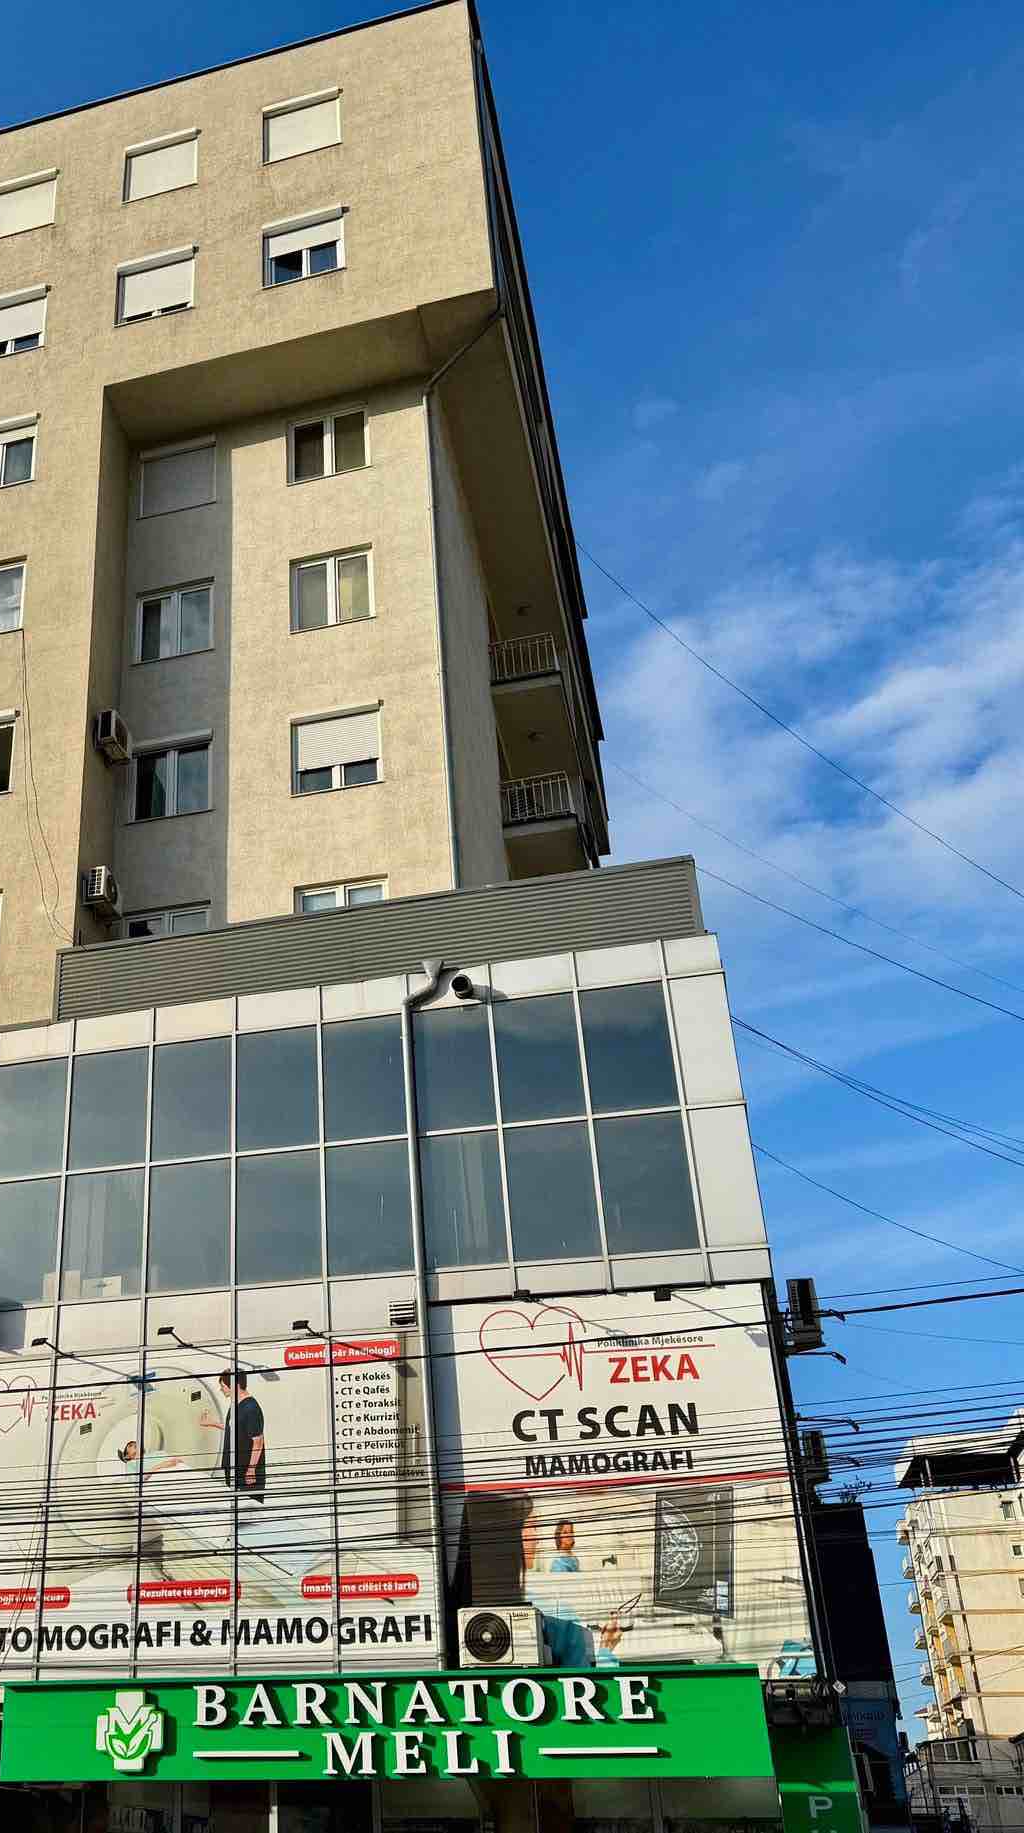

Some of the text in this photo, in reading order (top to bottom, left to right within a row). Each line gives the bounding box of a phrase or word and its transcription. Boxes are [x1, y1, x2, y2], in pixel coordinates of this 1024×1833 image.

[652, 1335, 704, 1346] Mjekësore
[608, 1353, 700, 1384] ZEKA
[341, 1374, 353, 1382] CT
[362, 1372, 391, 1381] Kokës
[341, 1387, 353, 1395] CT
[362, 1385, 390, 1395] Qafës
[341, 1401, 353, 1409] CT
[341, 1414, 354, 1422] CT
[363, 1412, 400, 1421] Kurrizit
[512, 1402, 700, 1442] CT SCAN
[342, 1428, 354, 1436] CT
[342, 1442, 354, 1450] CT
[525, 1450, 694, 1476] MAMOGRAFI
[303, 1583, 336, 1592] Imazh
[140, 1588, 181, 1598] Rezultate
[189, 1619, 212, 1646] &
[221, 1614, 433, 1646] MAMOGRAFI
[192, 1675, 655, 1727] BARNATORE
[321, 1729, 516, 1775] MELI
